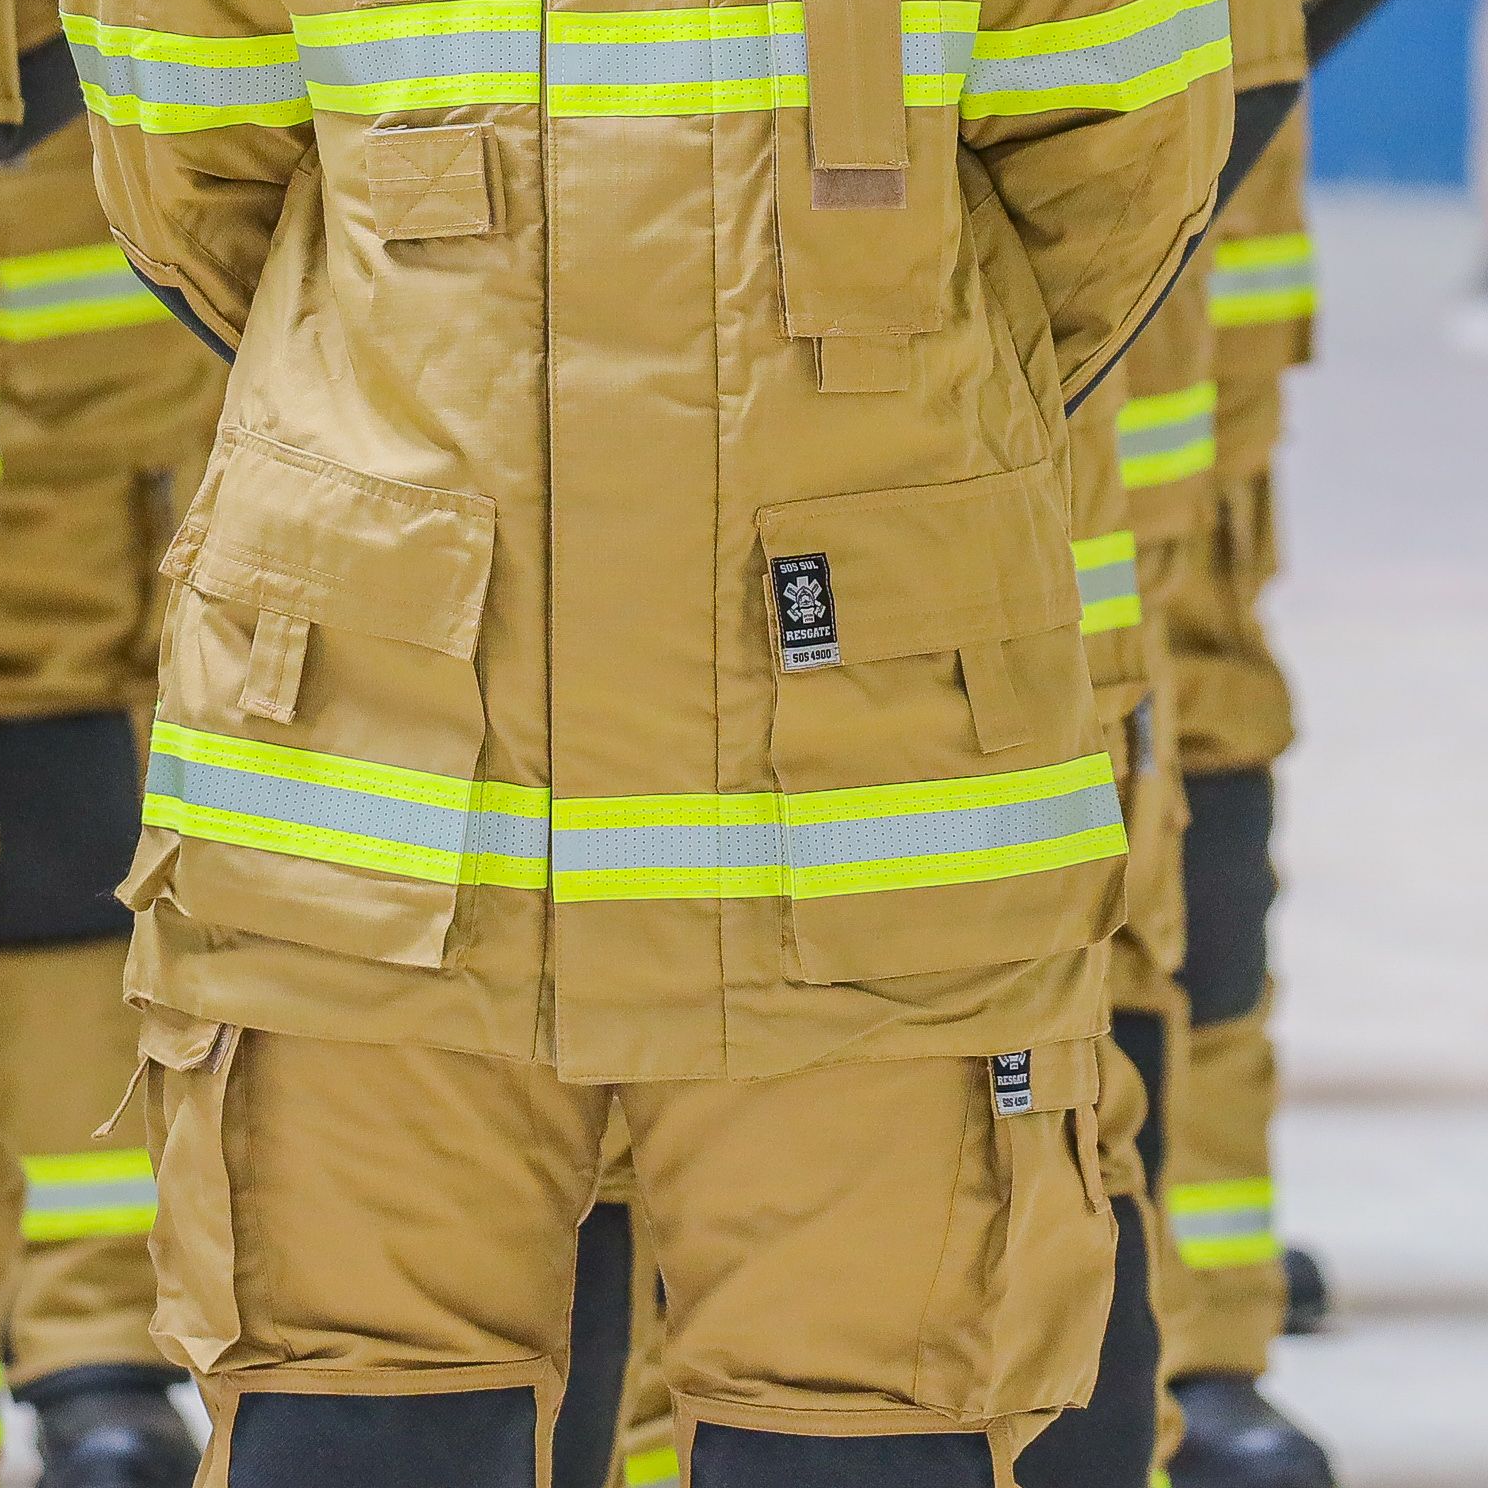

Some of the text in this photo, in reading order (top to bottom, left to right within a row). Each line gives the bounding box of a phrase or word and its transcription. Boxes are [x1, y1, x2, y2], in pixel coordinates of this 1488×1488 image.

[779, 560, 819, 574] SOS SUL
[785, 626, 831, 642] RESGATE
[792, 649, 832, 663] SOS 4900
[996, 1073, 1028, 1086] RESGATE
